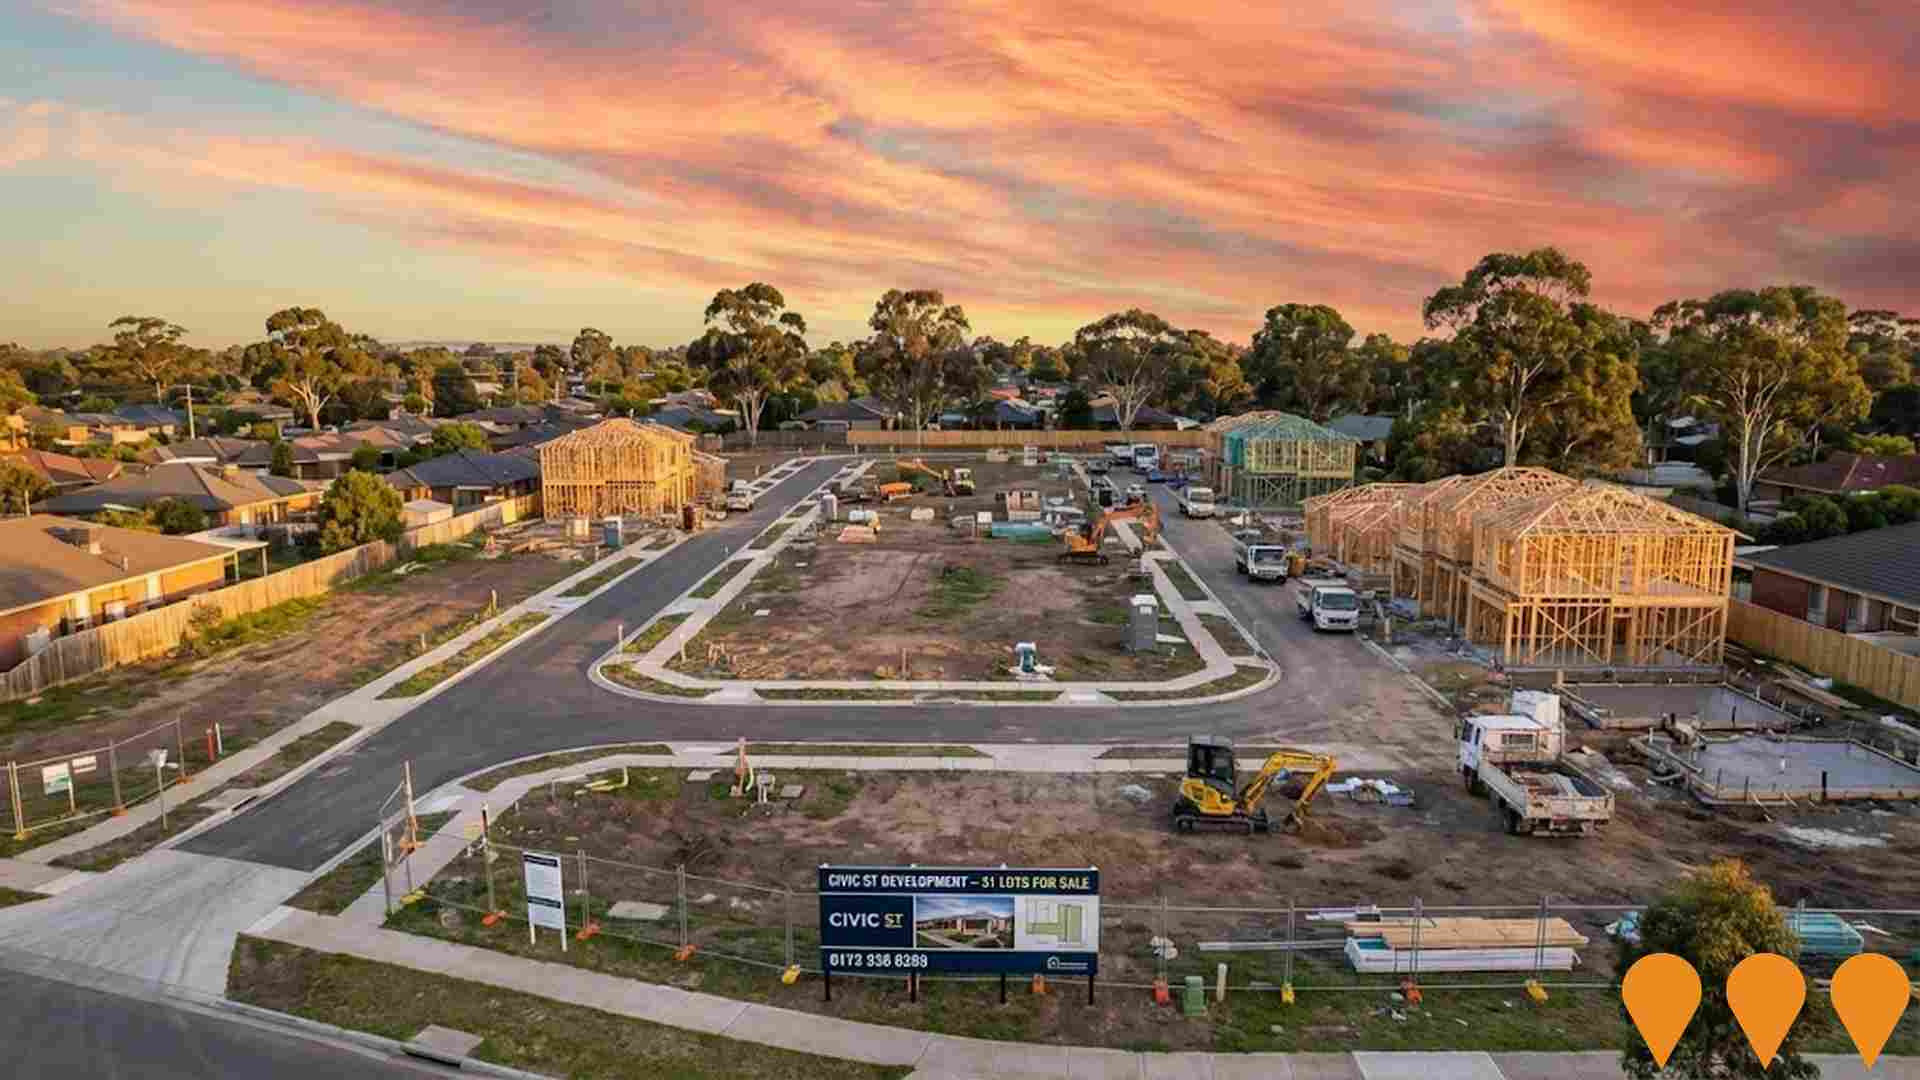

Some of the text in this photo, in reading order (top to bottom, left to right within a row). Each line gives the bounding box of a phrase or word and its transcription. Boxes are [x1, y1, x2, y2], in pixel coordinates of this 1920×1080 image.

[828, 873, 861, 888] CIVIC
[862, 874, 879, 888] ST
[881, 874, 969, 889] DEVELOPMENT
[998, 875, 1030, 889] LOTS
[1032, 876, 1057, 889] FOR
[1059, 876, 1090, 890] SALE
[829, 912, 905, 928] CIVIC ST
